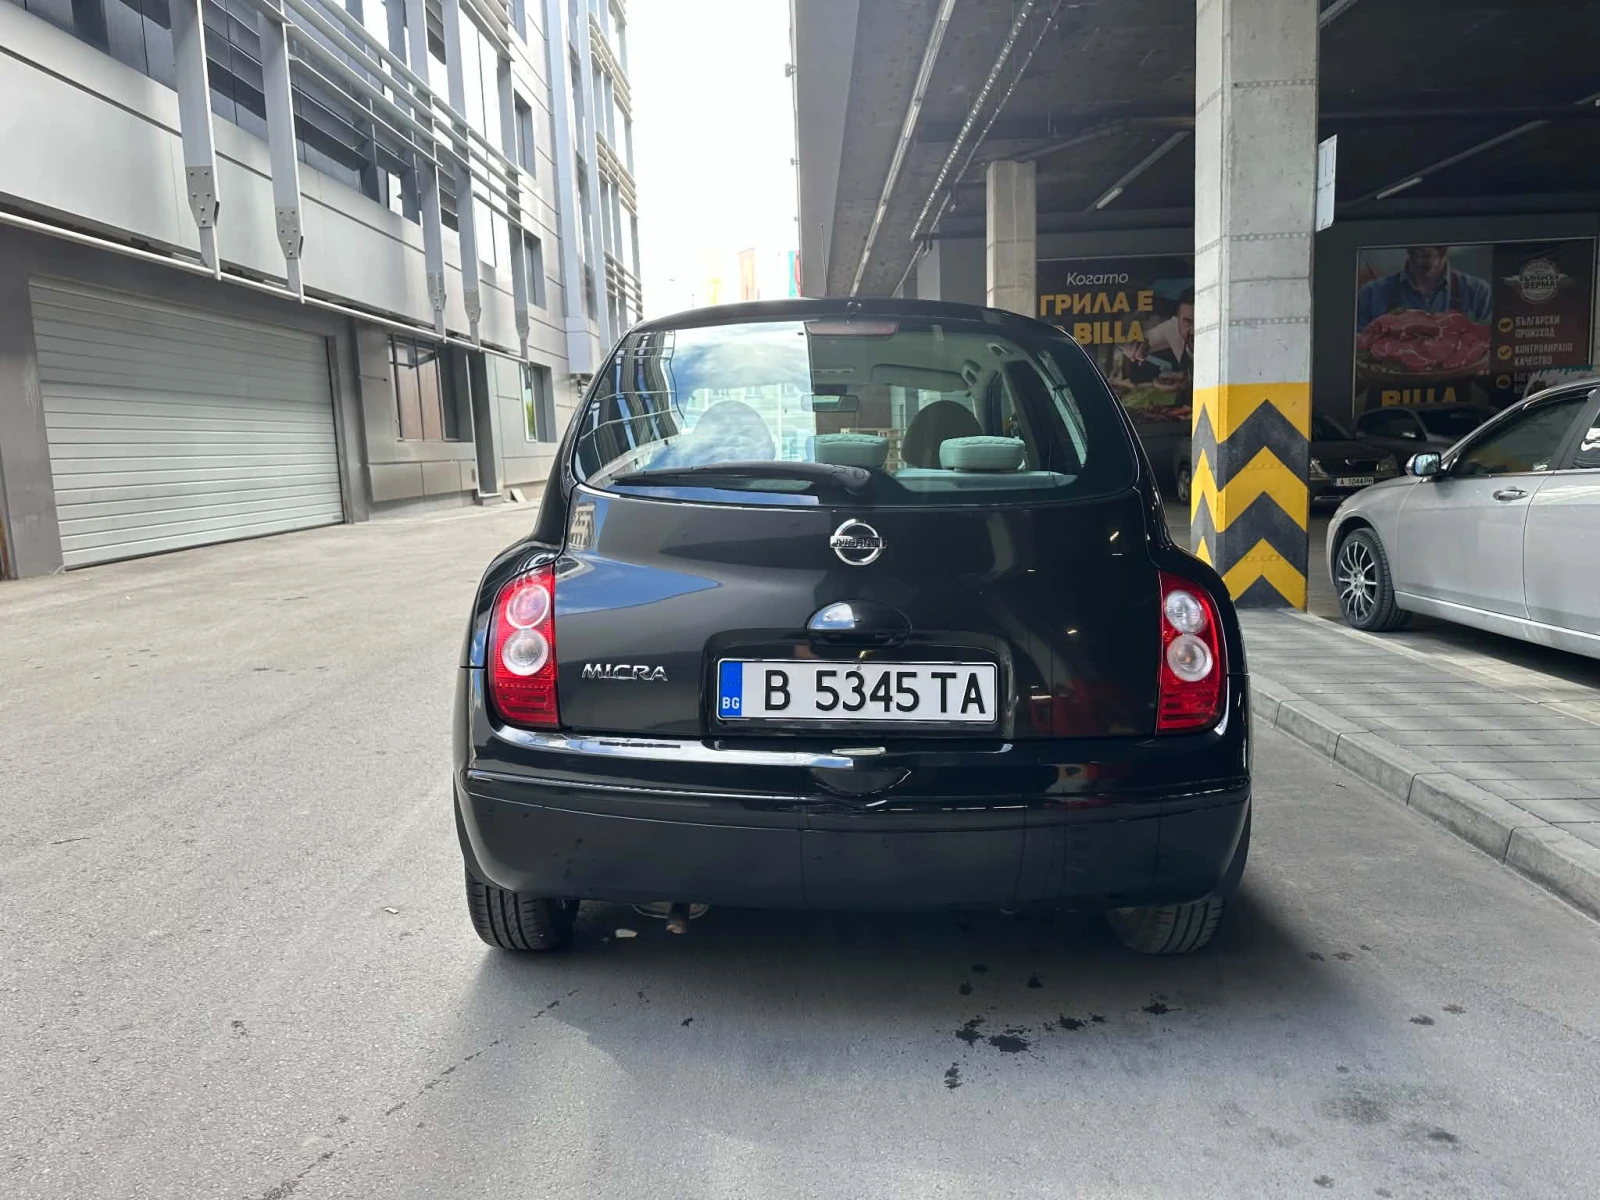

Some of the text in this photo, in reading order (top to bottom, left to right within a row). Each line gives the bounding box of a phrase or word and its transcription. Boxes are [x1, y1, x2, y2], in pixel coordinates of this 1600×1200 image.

[1066, 272, 1129, 286] Когато
[1523, 280, 1556, 289] ФЕРМА
[1039, 289, 1154, 317] ГРИЛА Е
[1515, 315, 1560, 326] БЪЛГАРСКИ
[1073, 319, 1145, 345] BILLA
[1515, 328, 1555, 339] ПРОИЗХОД
[1514, 342, 1573, 354] КОНТРОЛИРАНО
[1513, 355, 1553, 367] КАЧЕСТВО
[835, 538, 880, 548] NISSAN
[581, 663, 669, 681] MICRA
[764, 670, 986, 714] B 5345 TA
[722, 697, 740, 709] BG
